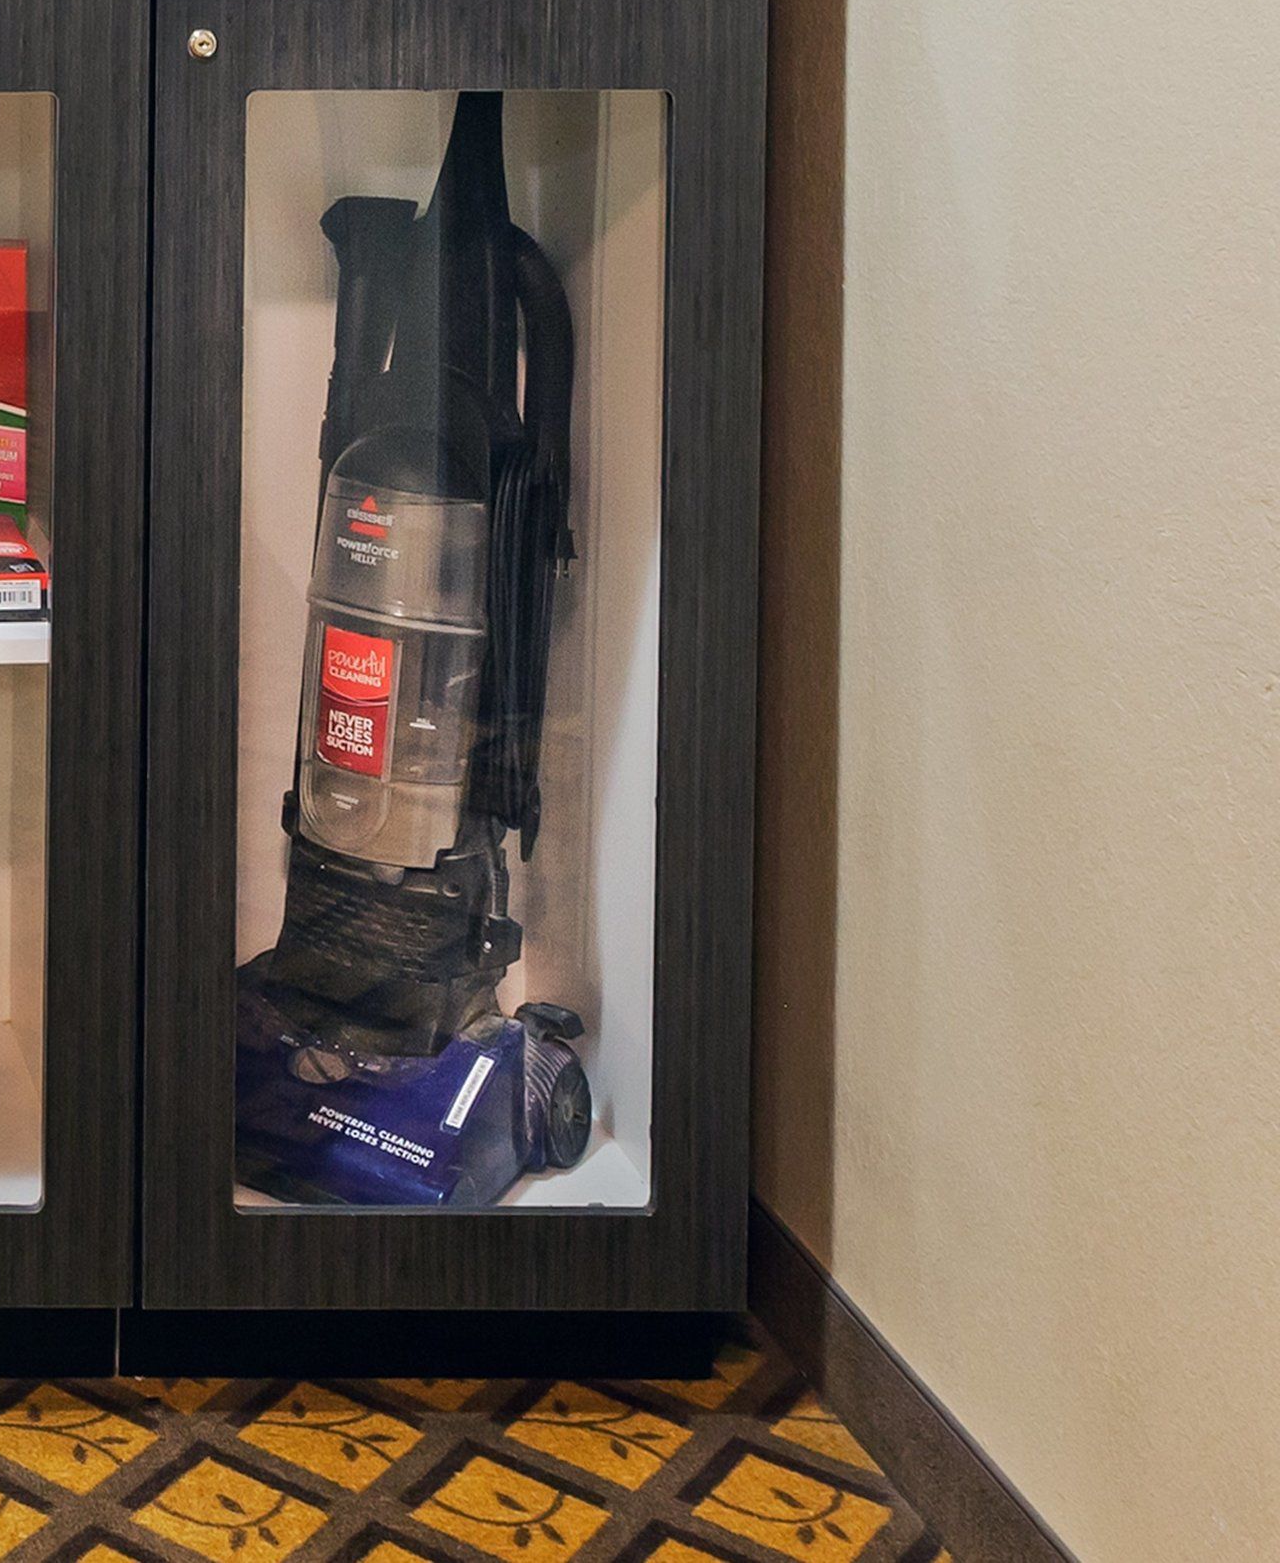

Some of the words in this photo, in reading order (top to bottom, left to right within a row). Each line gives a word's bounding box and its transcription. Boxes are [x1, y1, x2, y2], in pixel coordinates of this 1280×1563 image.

[327, 649, 387, 678] powerful
[328, 667, 382, 688] CLEANING
[328, 708, 375, 732] NEVER
[327, 722, 373, 745] LOSES
[326, 735, 374, 757] SUCTION
[307, 1110, 343, 1133] NEVER
[344, 1126, 379, 1148] LOSES
[380, 1140, 430, 1169] SUCTION
[319, 1105, 377, 1136] POWERFUL
[378, 1128, 435, 1159] CLEANING
